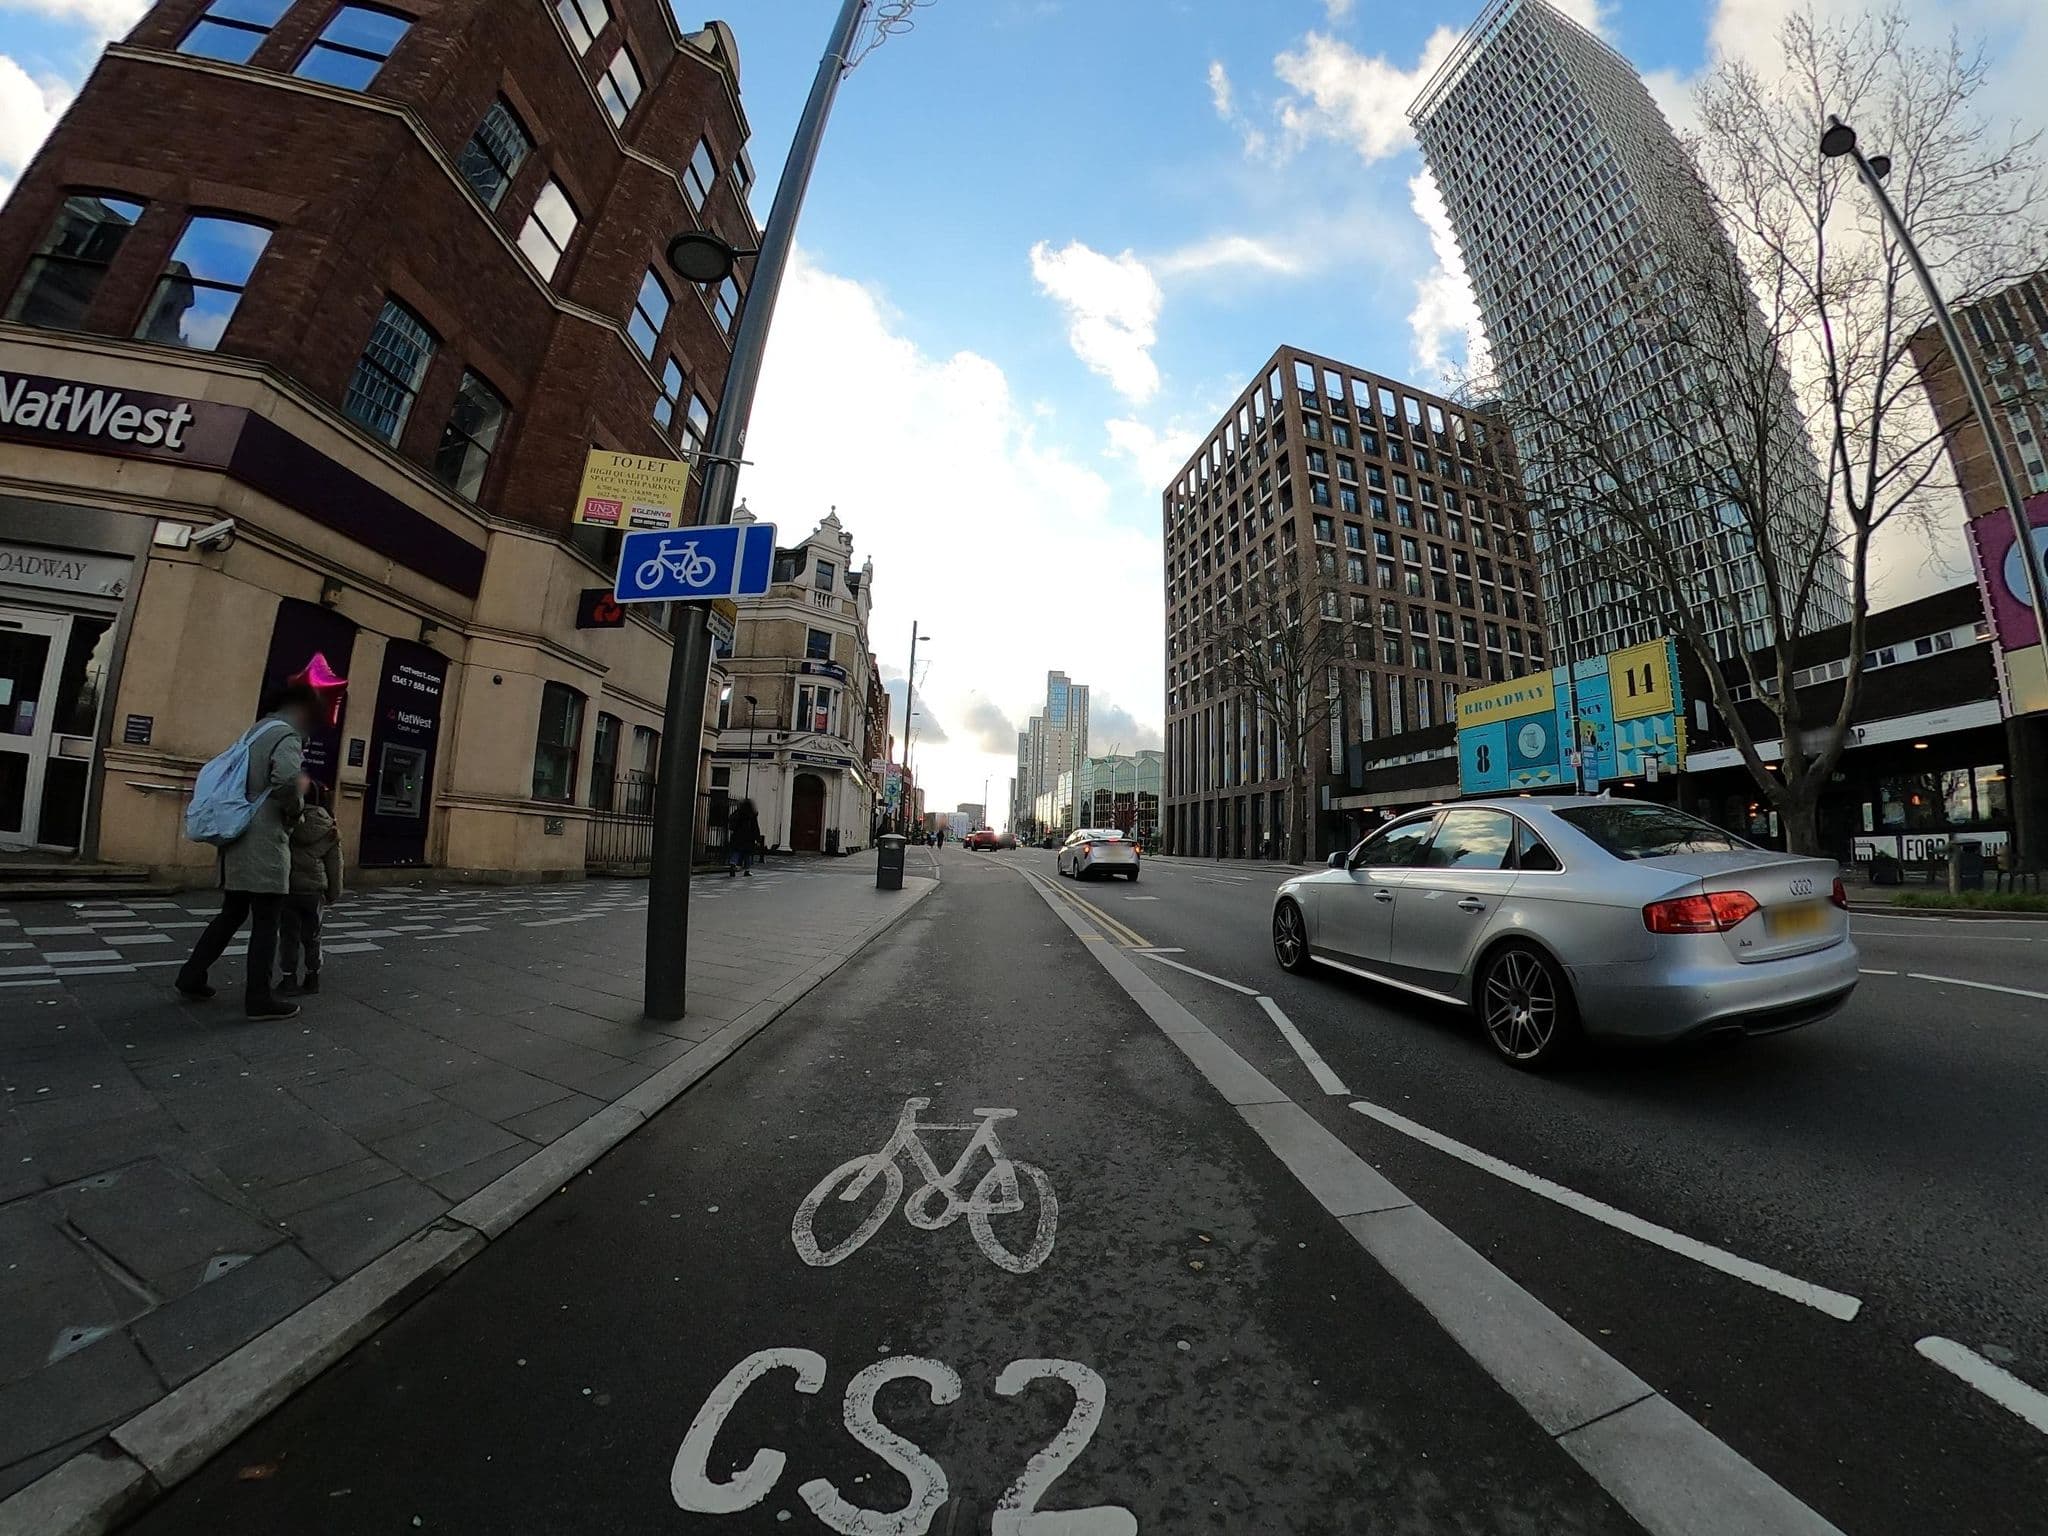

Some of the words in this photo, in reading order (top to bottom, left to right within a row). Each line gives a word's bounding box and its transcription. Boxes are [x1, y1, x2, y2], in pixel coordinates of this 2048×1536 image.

[0, 375, 192, 448] NatWest
[611, 455, 633, 468] TO
[637, 459, 668, 473] LET
[589, 467, 612, 476] HIGH
[613, 470, 651, 481] QUALITY
[651, 475, 681, 486] OFFICE
[590, 475, 614, 484] SPACE
[617, 478, 640, 488] WITH
[641, 481, 680, 493] PARKING
[588, 502, 618, 515] UNEX
[636, 507, 665, 517] GLENNY
[400, 665, 441, 683] natwest.com
[1625, 663, 1655, 697] 14
[408, 679, 413, 687] 7
[413, 681, 425, 692] 888
[426, 685, 439, 695] 444
[1464, 685, 1545, 715] BROADWAY
[398, 711, 432, 728] NatWest
[1564, 703, 1603, 720] FNCY
[670, 1347, 1138, 1536] CS2
